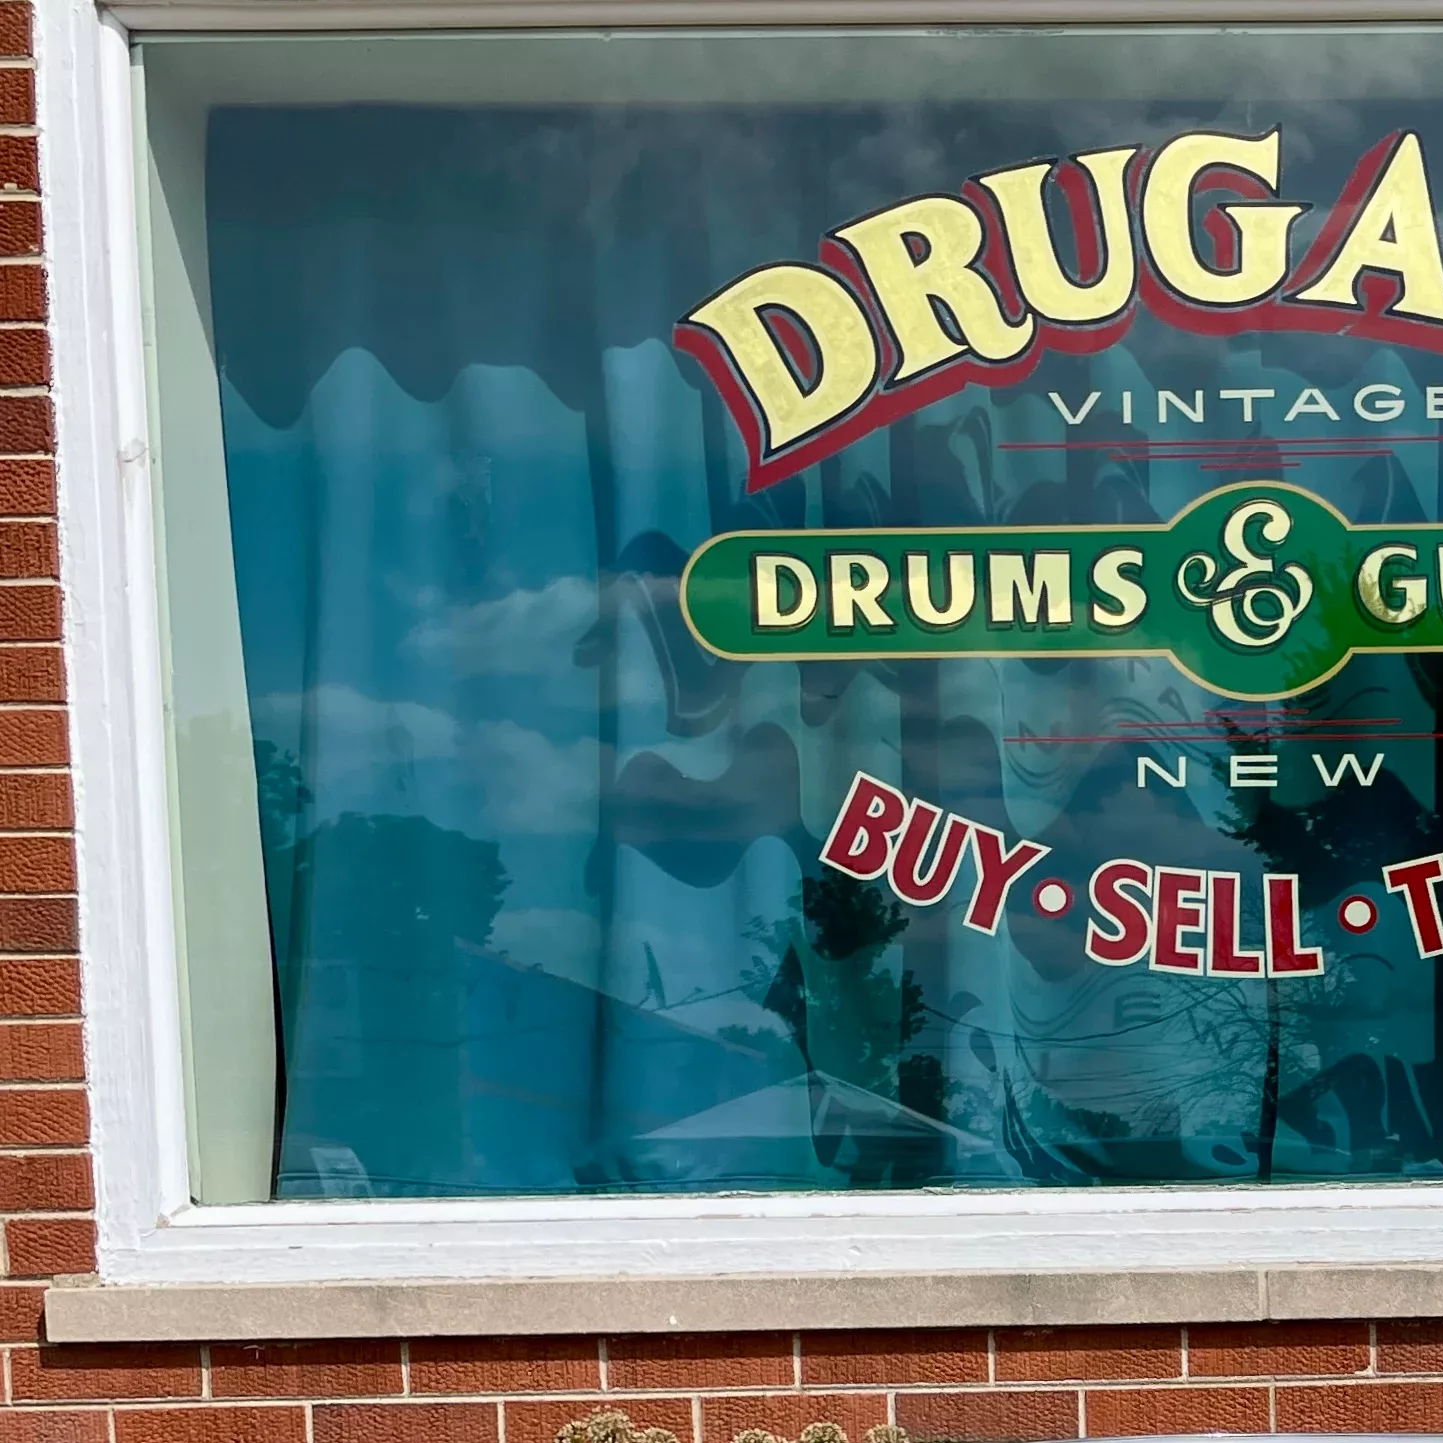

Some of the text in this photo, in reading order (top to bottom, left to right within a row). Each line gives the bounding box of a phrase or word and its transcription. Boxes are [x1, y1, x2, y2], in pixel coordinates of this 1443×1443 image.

[751, 546, 1149, 630] DRUMS
[1177, 499, 1314, 648] &
[1136, 752, 1387, 789] NEW
[819, 771, 1052, 936] BUY
[1084, 858, 1324, 979] SELL
